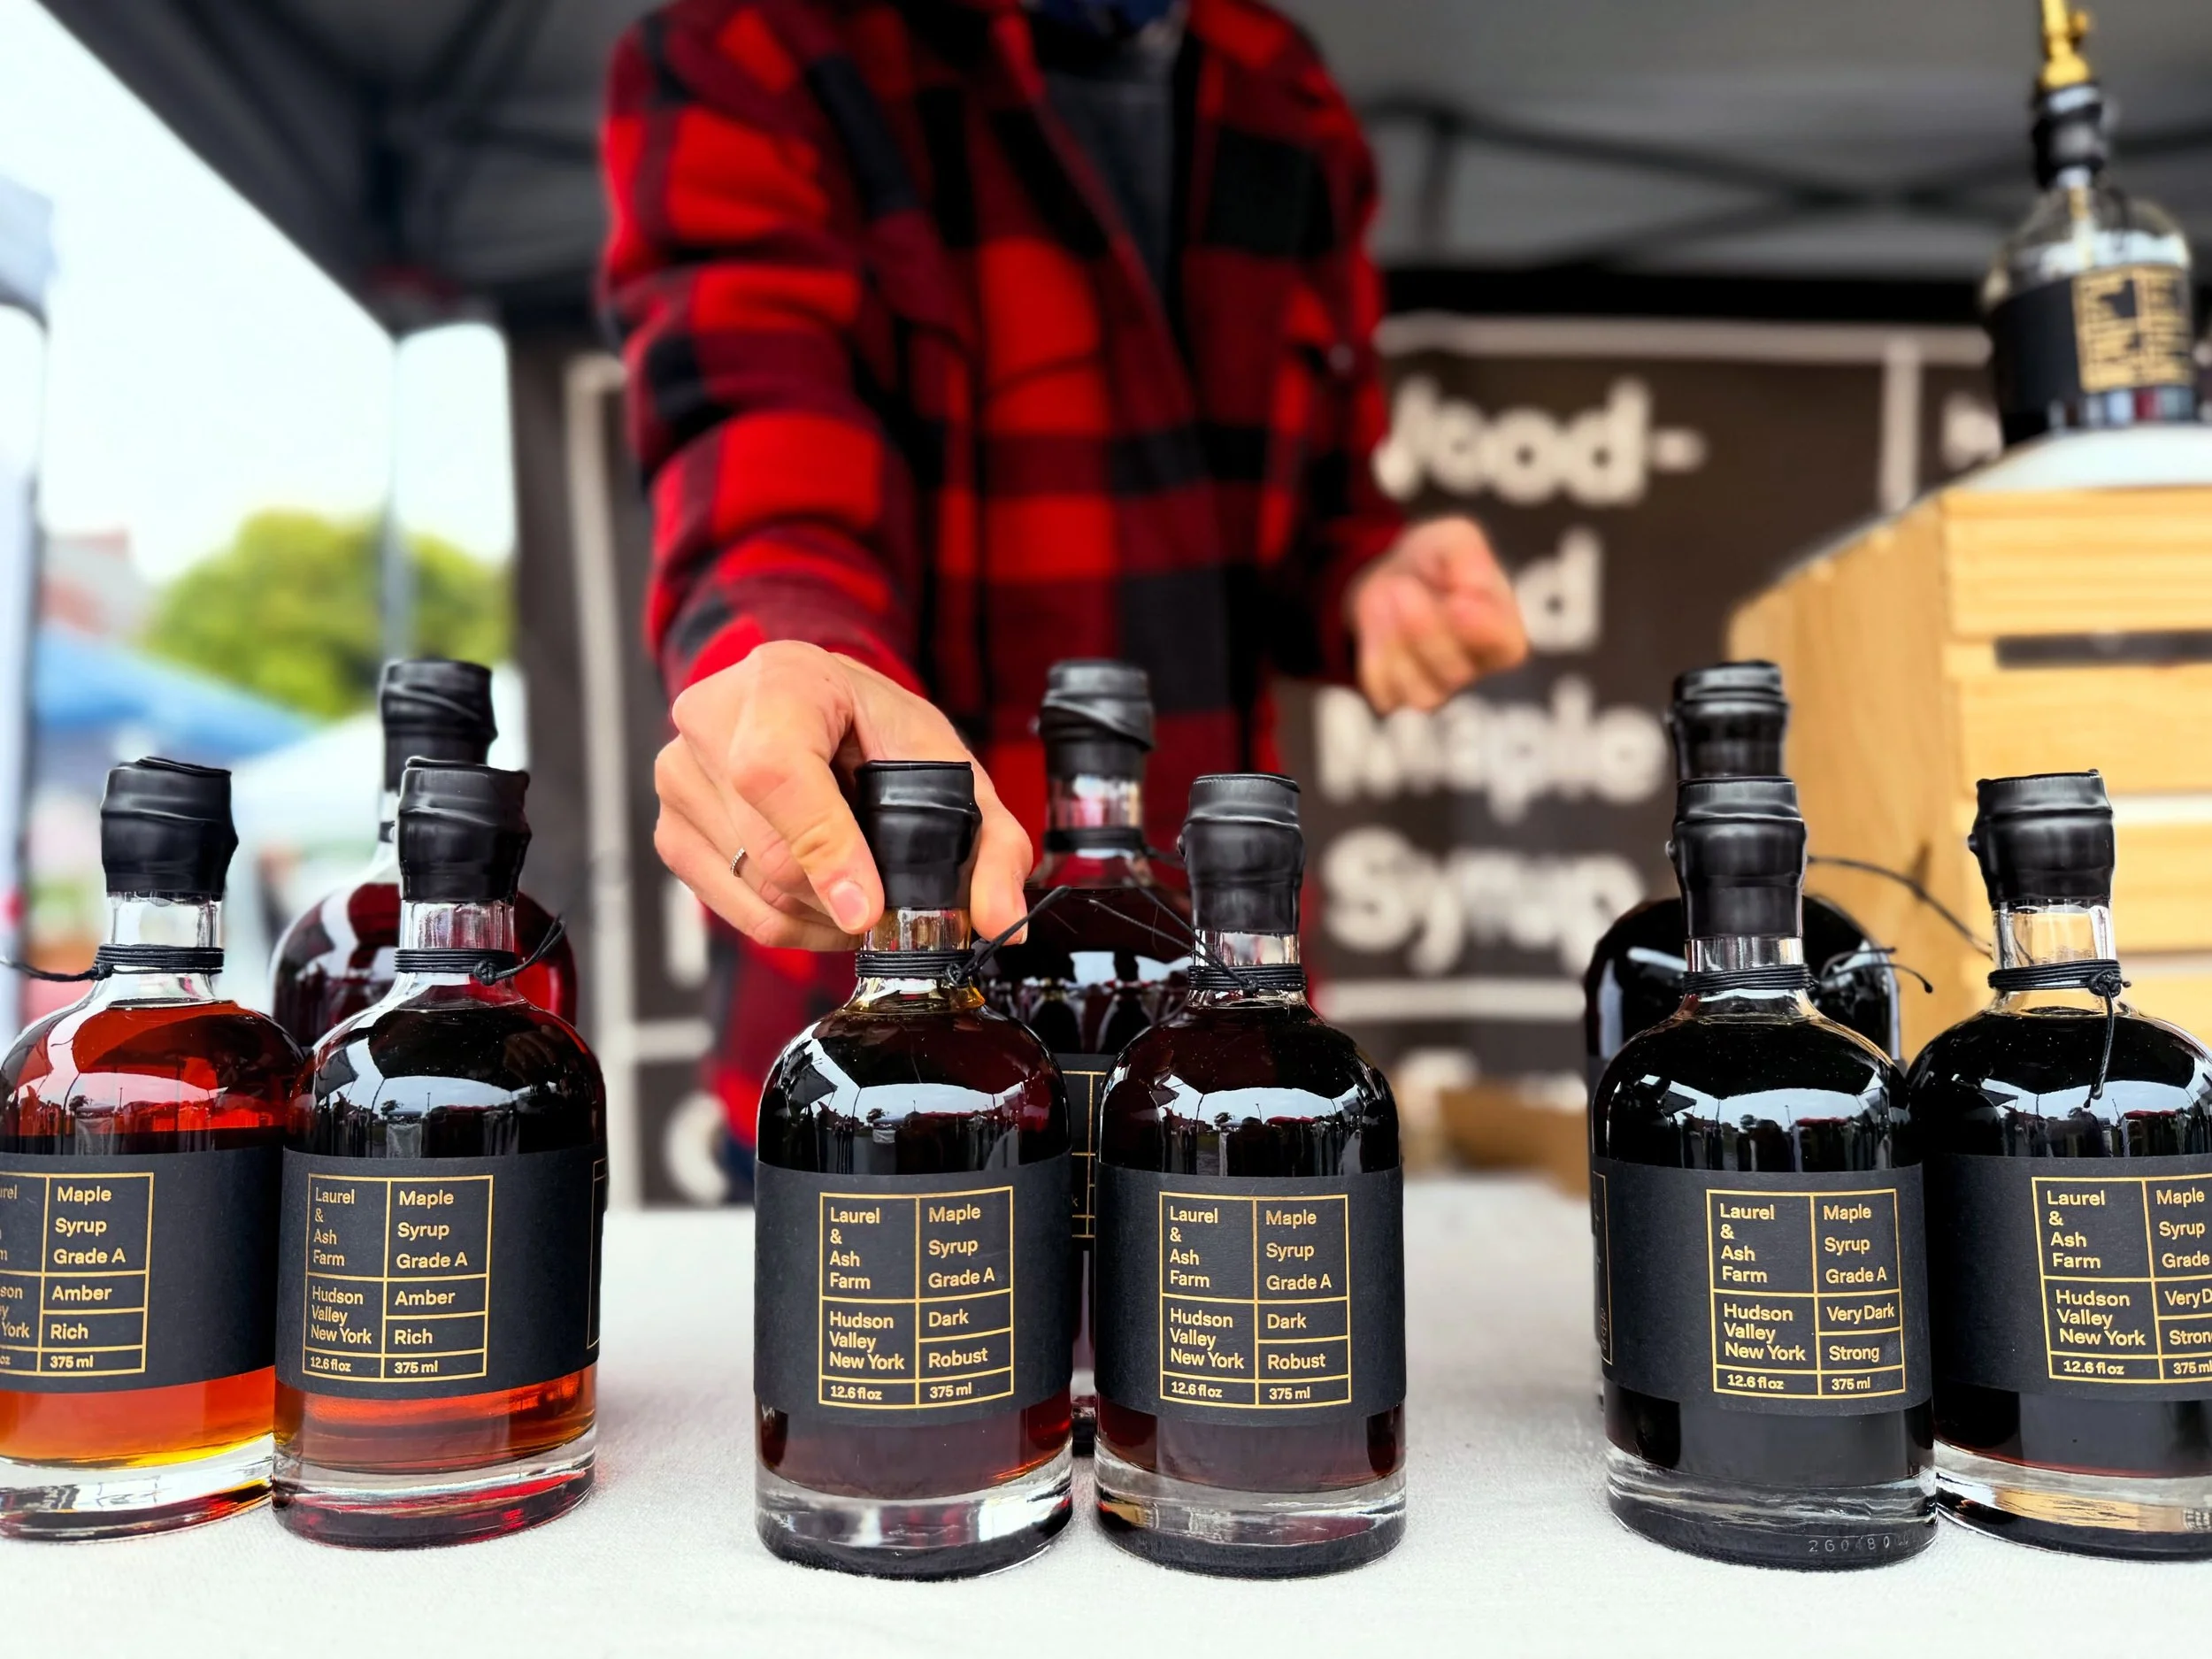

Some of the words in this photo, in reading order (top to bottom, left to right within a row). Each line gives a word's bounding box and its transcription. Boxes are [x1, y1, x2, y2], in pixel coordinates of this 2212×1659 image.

[1322, 826, 1647, 974] Syrup
[0, 1184, 17, 1199] rel
[58, 1186, 111, 1205] Maple
[315, 1187, 356, 1205] Laurel
[399, 1189, 454, 1209] Maple
[2047, 1189, 2106, 1207] Laurel
[2156, 1187, 2205, 1208] Maple
[314, 1208, 324, 1223] &
[830, 1206, 880, 1225] Laurel
[929, 1204, 981, 1225] Maple
[1170, 1206, 1218, 1225] Laurel
[1266, 1210, 1317, 1230] Maple
[1720, 1202, 1776, 1220] Laurel
[1824, 1202, 1872, 1224] Maple
[2049, 1210, 2064, 1226] &
[55, 1217, 107, 1237] Syrup
[397, 1222, 449, 1241] Syrup
[830, 1228, 842, 1245] &
[1170, 1227, 1182, 1243] &
[1720, 1224, 1735, 1240] &
[2159, 1221, 2206, 1240] Syrup
[314, 1229, 336, 1246] Ash
[1824, 1236, 1870, 1256] Syrup
[2051, 1231, 2087, 1248] Ash
[53, 1248, 108, 1265] Grade
[111, 1248, 126, 1263] A
[313, 1249, 345, 1267] Farm
[929, 1239, 979, 1259] Syrup
[1170, 1248, 1200, 1266] Ash
[1266, 1242, 1315, 1263] Syrup
[1721, 1244, 1756, 1262] Ash
[396, 1253, 451, 1270] Grade
[455, 1252, 468, 1267] A
[829, 1250, 861, 1268] Ash
[2052, 1252, 2101, 1269] Farm
[2162, 1250, 2210, 1269] Grade
[830, 1272, 871, 1290] Farm
[928, 1269, 980, 1289] Grade
[983, 1267, 995, 1283] A
[1170, 1270, 1210, 1288] Farm
[1266, 1274, 1317, 1291] Grade
[1320, 1274, 1333, 1289] A
[1722, 1265, 1768, 1284] Farm
[1825, 1267, 1874, 1285] Grade
[1877, 1267, 1887, 1282] A
[0, 1286, 23, 1300] son
[52, 1285, 112, 1302] Amber
[311, 1286, 364, 1305] Hudson
[395, 1289, 456, 1307] Amber
[2056, 1289, 2130, 1307] Hudson
[2164, 1290, 2200, 1309] Very
[311, 1304, 348, 1326] Valley
[829, 1310, 894, 1330] Hudson
[929, 1309, 970, 1328] Dark
[1170, 1308, 1233, 1329] Hudson
[1267, 1311, 1307, 1330] Dark
[1724, 1302, 1793, 1322] Hudson
[1826, 1305, 1862, 1325] Very
[1863, 1302, 1895, 1321] Dark
[2056, 1308, 2113, 1330] Valley
[2, 1321, 30, 1339] York
[50, 1322, 88, 1340] Rich
[311, 1324, 336, 1341] New
[340, 1326, 373, 1345] York
[395, 1328, 433, 1346] Rich
[1170, 1327, 1217, 1351] Valley
[1724, 1322, 1777, 1344] Valley
[2060, 1327, 2101, 1346] New
[2104, 1329, 2147, 1346] York
[2169, 1329, 2212, 1346] Stron
[829, 1331, 876, 1353] Valley
[1724, 1341, 1764, 1360] New
[1767, 1343, 1807, 1362] York
[50, 1356, 73, 1369] 375
[77, 1354, 94, 1367] ml
[829, 1351, 864, 1369] New
[867, 1353, 905, 1371] York
[929, 1347, 988, 1369] Robust
[1170, 1347, 1204, 1366] New
[1207, 1351, 1245, 1370] York
[1267, 1352, 1326, 1371] Robust
[1828, 1345, 1880, 1363] Strong
[395, 1362, 419, 1373] 375
[421, 1360, 438, 1372] ml
[2173, 1362, 2197, 1374] 375
[930, 1385, 954, 1399] 375
[956, 1381, 972, 1396] ml
[1832, 1378, 1855, 1390] 375
[1856, 1376, 1870, 1390] ml
[1269, 1387, 1293, 1400] 375
[1294, 1386, 1311, 1399] ml
